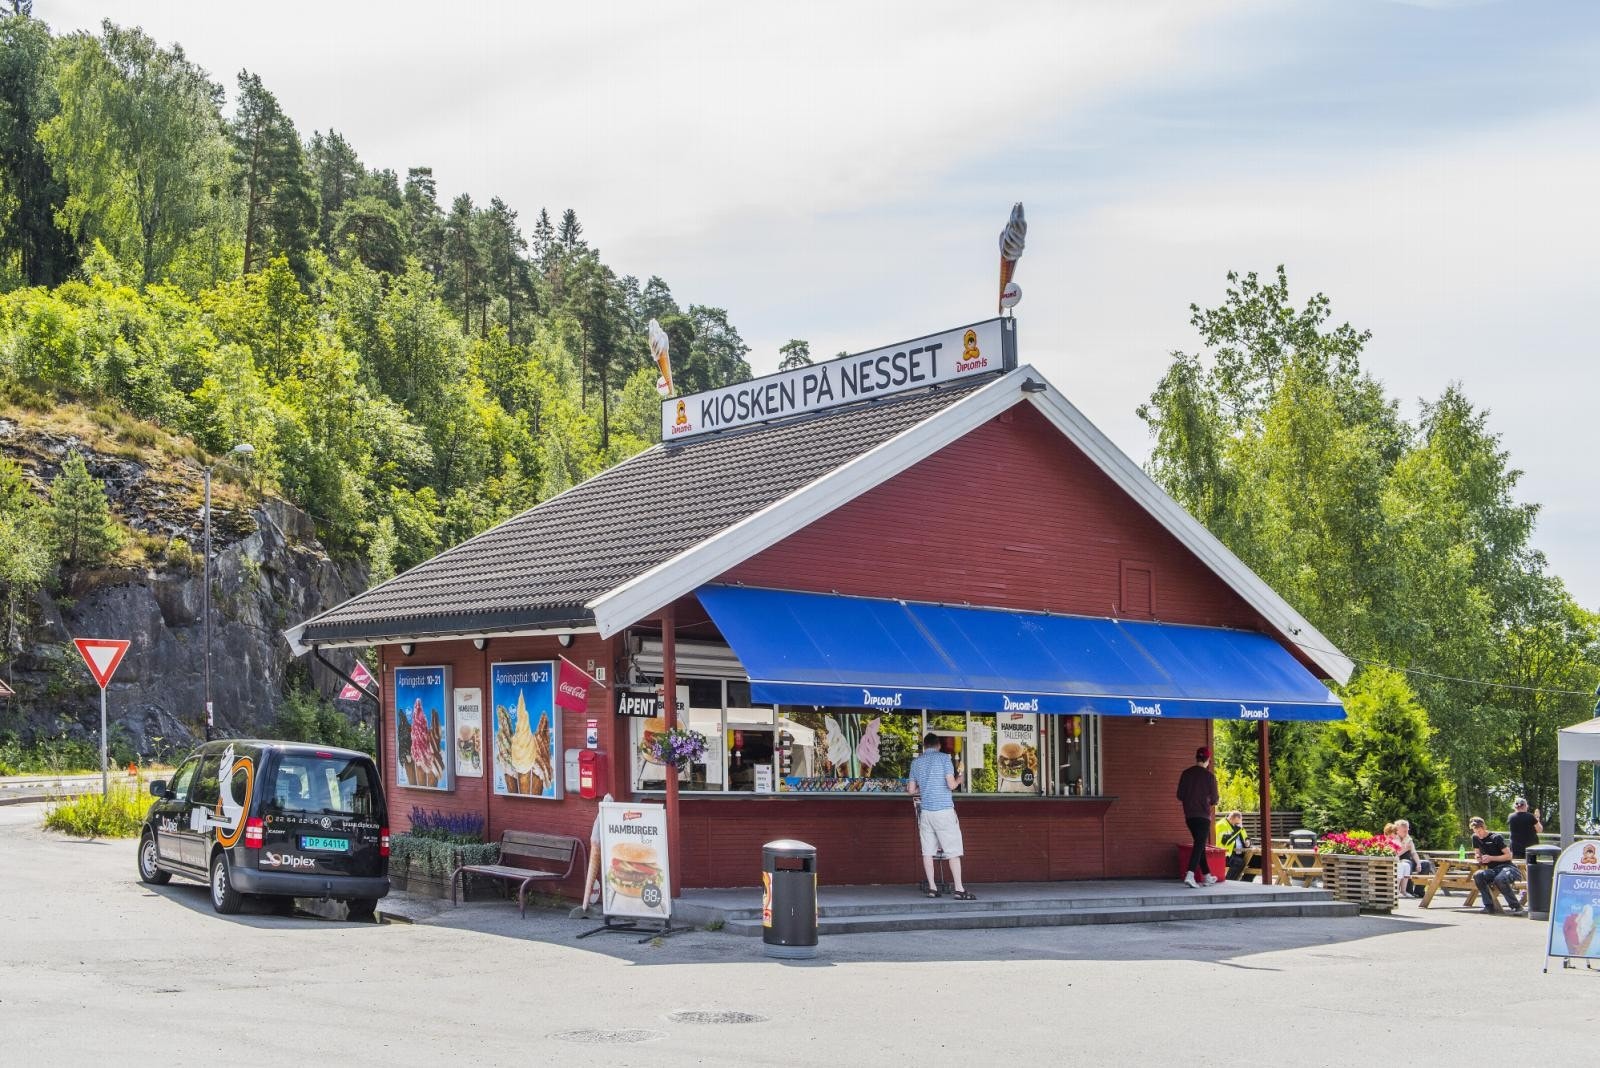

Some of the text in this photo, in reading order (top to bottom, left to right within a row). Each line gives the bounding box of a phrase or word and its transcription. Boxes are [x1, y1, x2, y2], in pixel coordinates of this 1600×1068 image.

[701, 343, 943, 429] KIOSKEN PÅ NESSET
[426, 675, 441, 685] 10-21
[531, 671, 549, 683] 10-21
[618, 692, 656, 715] ÅPENT
[1001, 722, 1034, 732] HAMBURGER
[608, 824, 658, 836] HAMBURGER
[309, 838, 346, 849] DP 64114
[282, 854, 316, 868] Diplex
